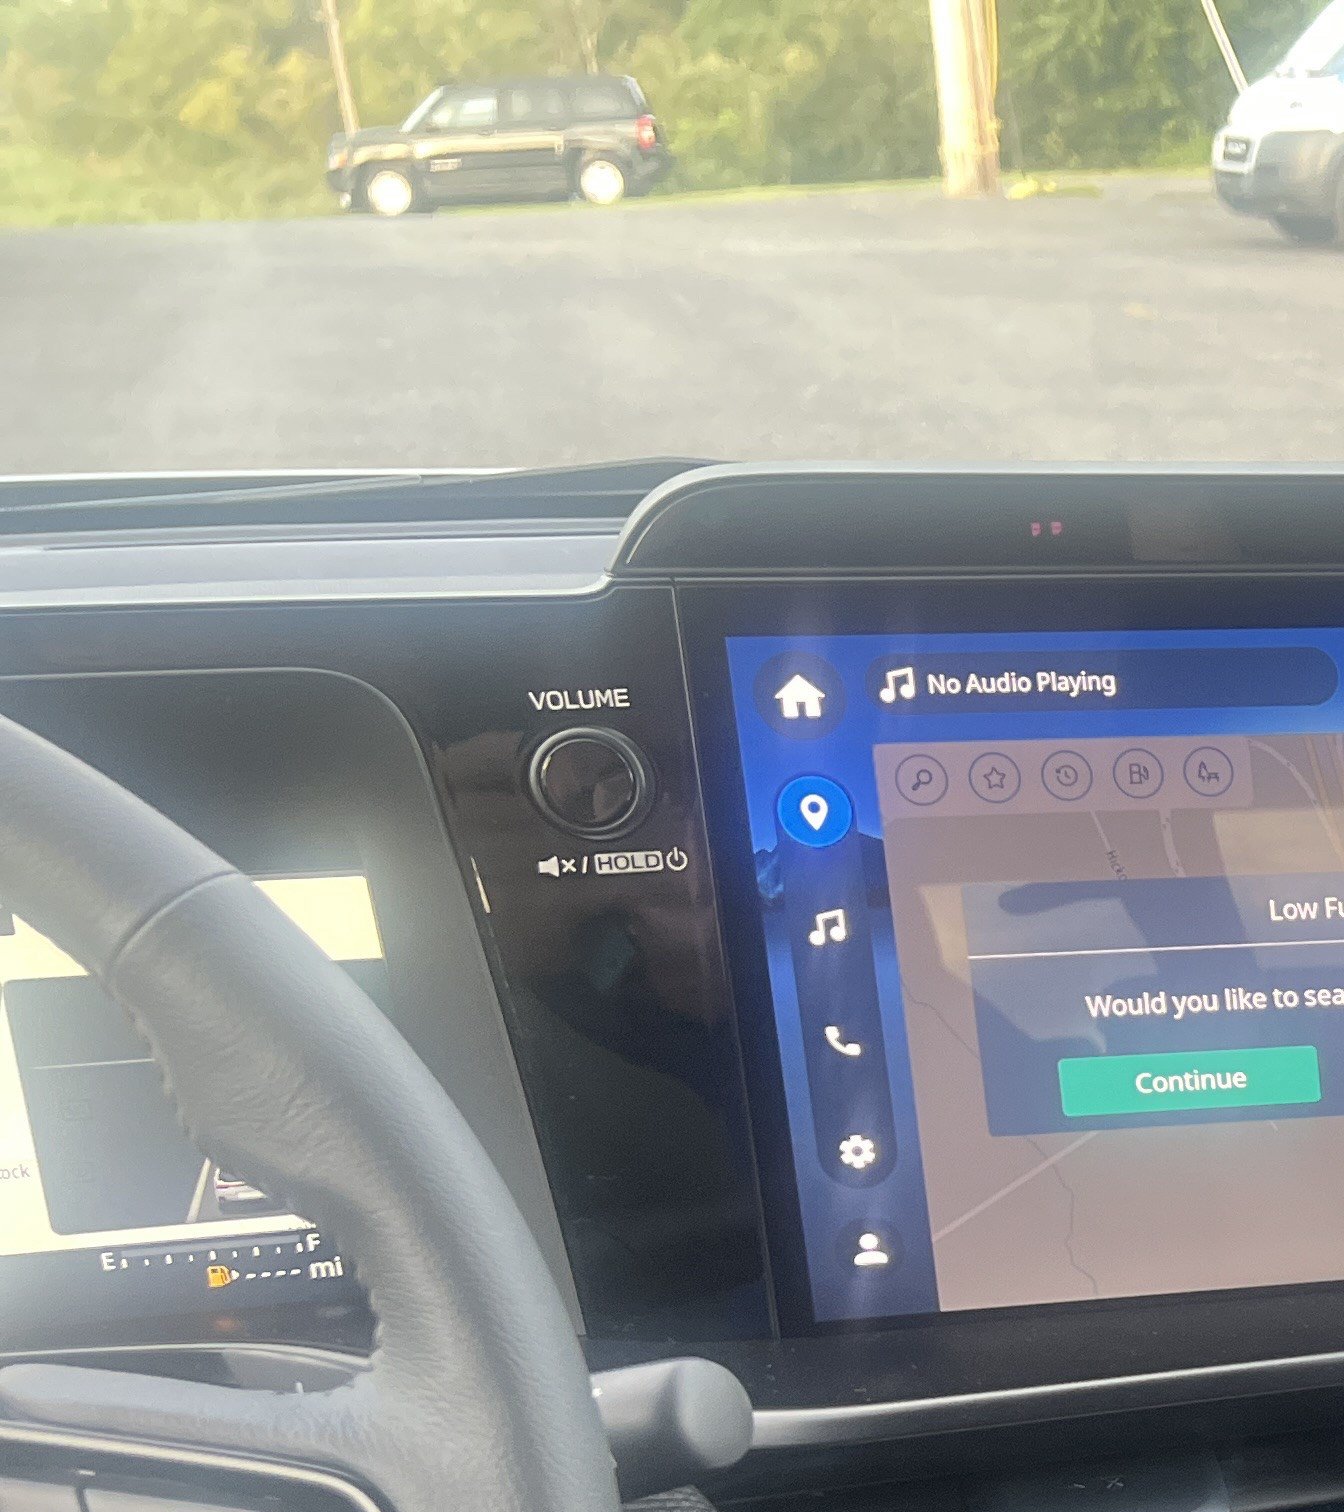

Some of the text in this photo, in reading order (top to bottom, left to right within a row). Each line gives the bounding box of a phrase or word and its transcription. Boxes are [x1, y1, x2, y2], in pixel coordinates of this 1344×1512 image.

[927, 670, 1117, 698] No Audio Playing
[528, 688, 631, 710] VOLUME
[597, 853, 661, 871] HOLD
[1269, 899, 1319, 921] Low
[1084, 991, 1168, 1019] Would
[1171, 993, 1220, 1020] you
[1223, 987, 1268, 1011] like
[1272, 987, 1300, 1009] to
[1135, 1069, 1248, 1094] Continue
[306, 1233, 321, 1252] F
[101, 1251, 117, 1272] E
[309, 1255, 344, 1280] mi
